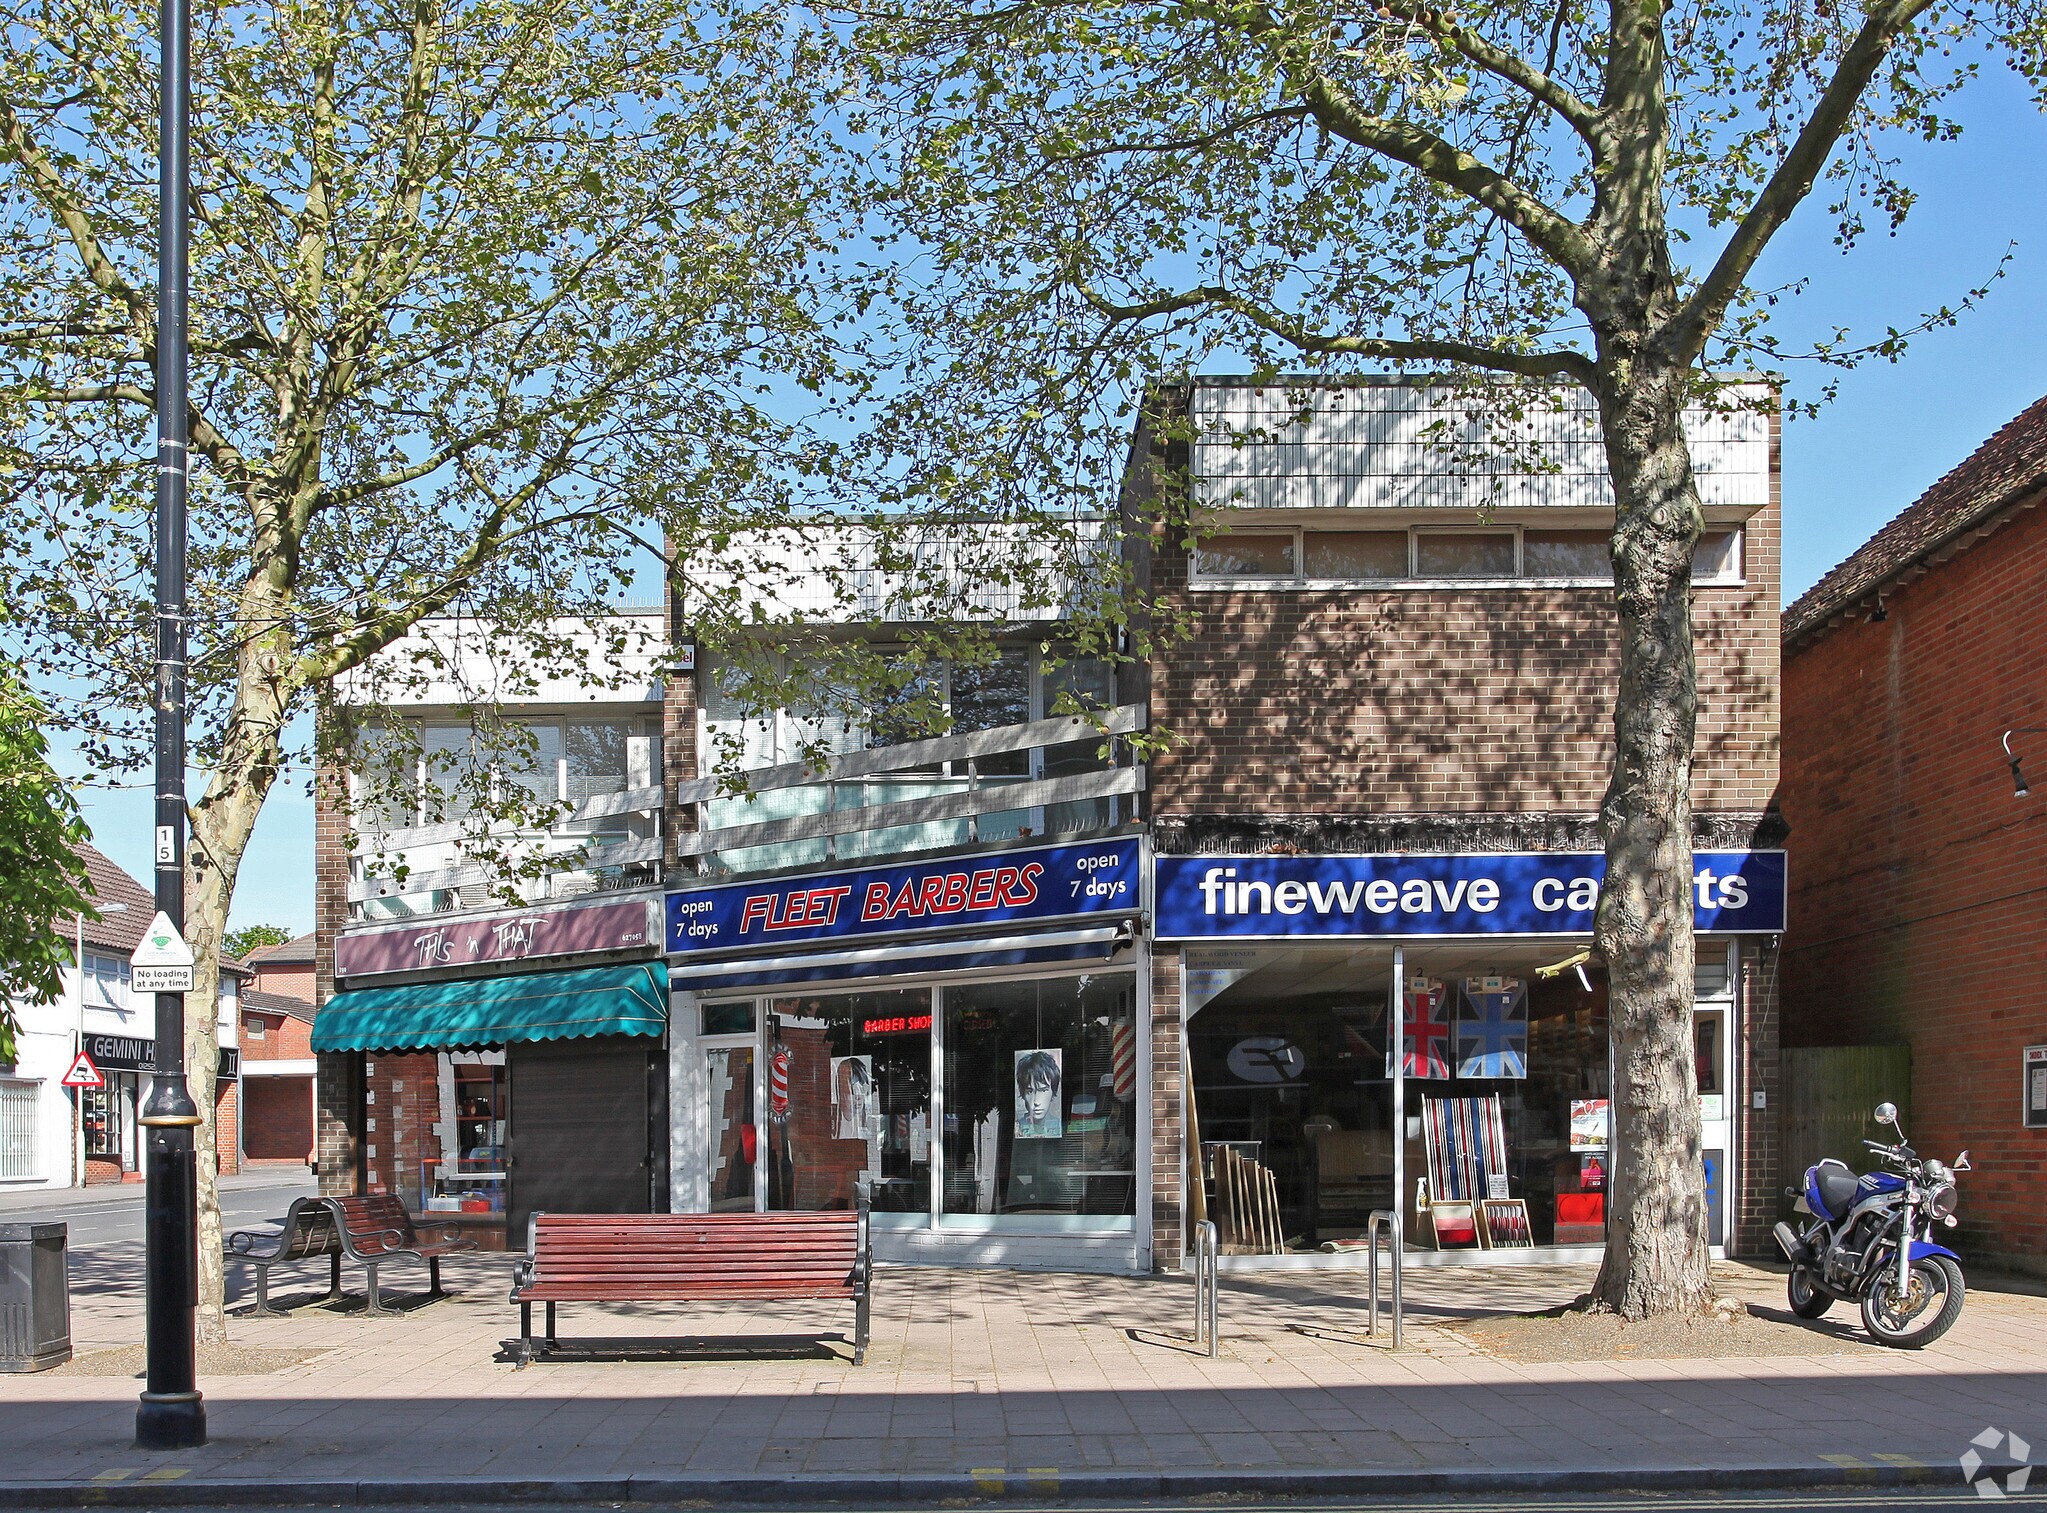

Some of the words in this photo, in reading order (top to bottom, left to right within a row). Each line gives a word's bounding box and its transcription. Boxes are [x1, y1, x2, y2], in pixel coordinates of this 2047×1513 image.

[1076, 854, 1119, 875] open
[739, 885, 852, 935] FLEET
[860, 862, 1045, 923] BARBERS
[1070, 879, 1081, 898] 7
[1085, 876, 1127, 900] days
[1198, 866, 1501, 915] fineweave
[1531, 867, 1750, 913] cats
[681, 900, 713, 918] open
[492, 918, 549, 956] THAT
[676, 922, 685, 938] 7
[688, 919, 719, 940] days
[136, 980, 146, 988] at
[137, 970, 151, 978] No
[153, 970, 188, 979] loading
[863, 1017, 906, 1033] BARBER
[908, 1015, 933, 1031] SHOP
[94, 1037, 141, 1061] GEMINI
